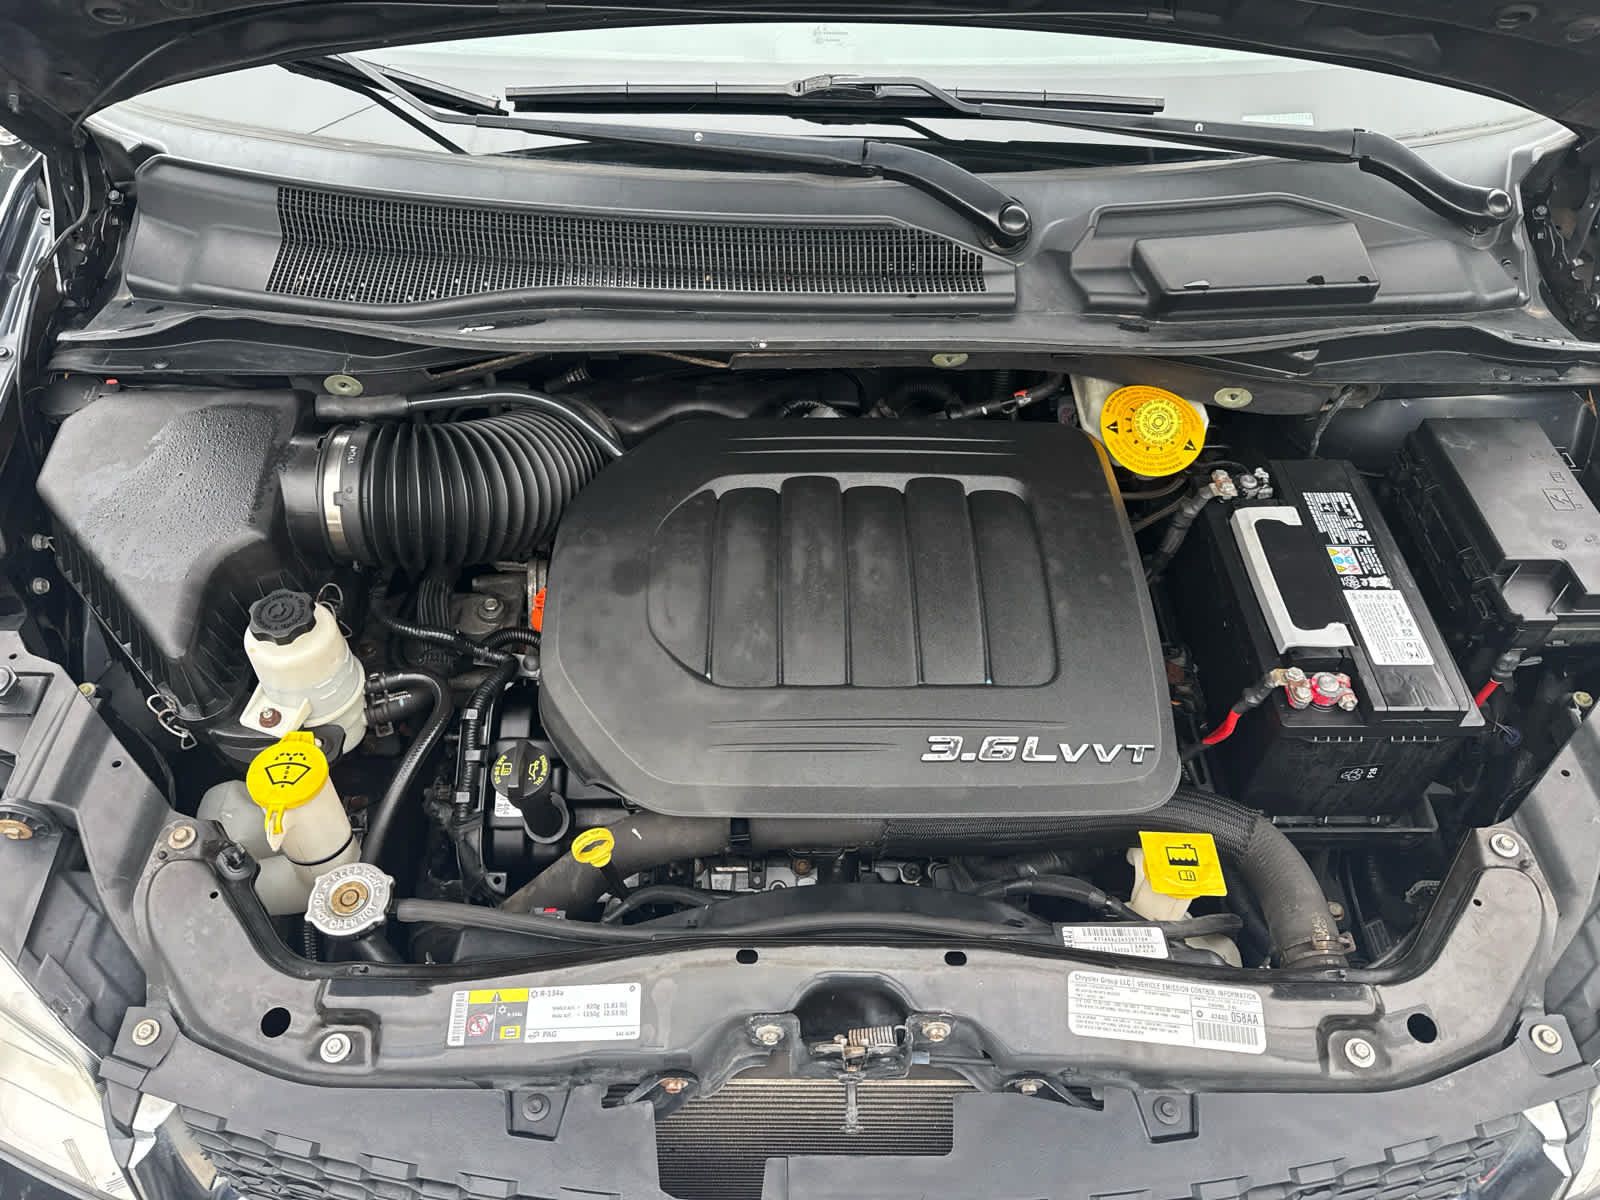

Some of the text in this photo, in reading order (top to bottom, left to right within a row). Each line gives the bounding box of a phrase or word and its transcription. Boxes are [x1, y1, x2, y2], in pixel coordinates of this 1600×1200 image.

[533, 776, 544, 785] OIL
[1075, 973, 1131, 986] Chrysler Group LLC
[539, 990, 564, 998] R-134a
[1137, 981, 1160, 990] VEHICLE
[1162, 984, 1189, 993] EMISSION
[1191, 986, 1215, 995] CONTROL
[1218, 989, 1257, 1000] INFORMATION
[1231, 1012, 1259, 1025] 058AA
